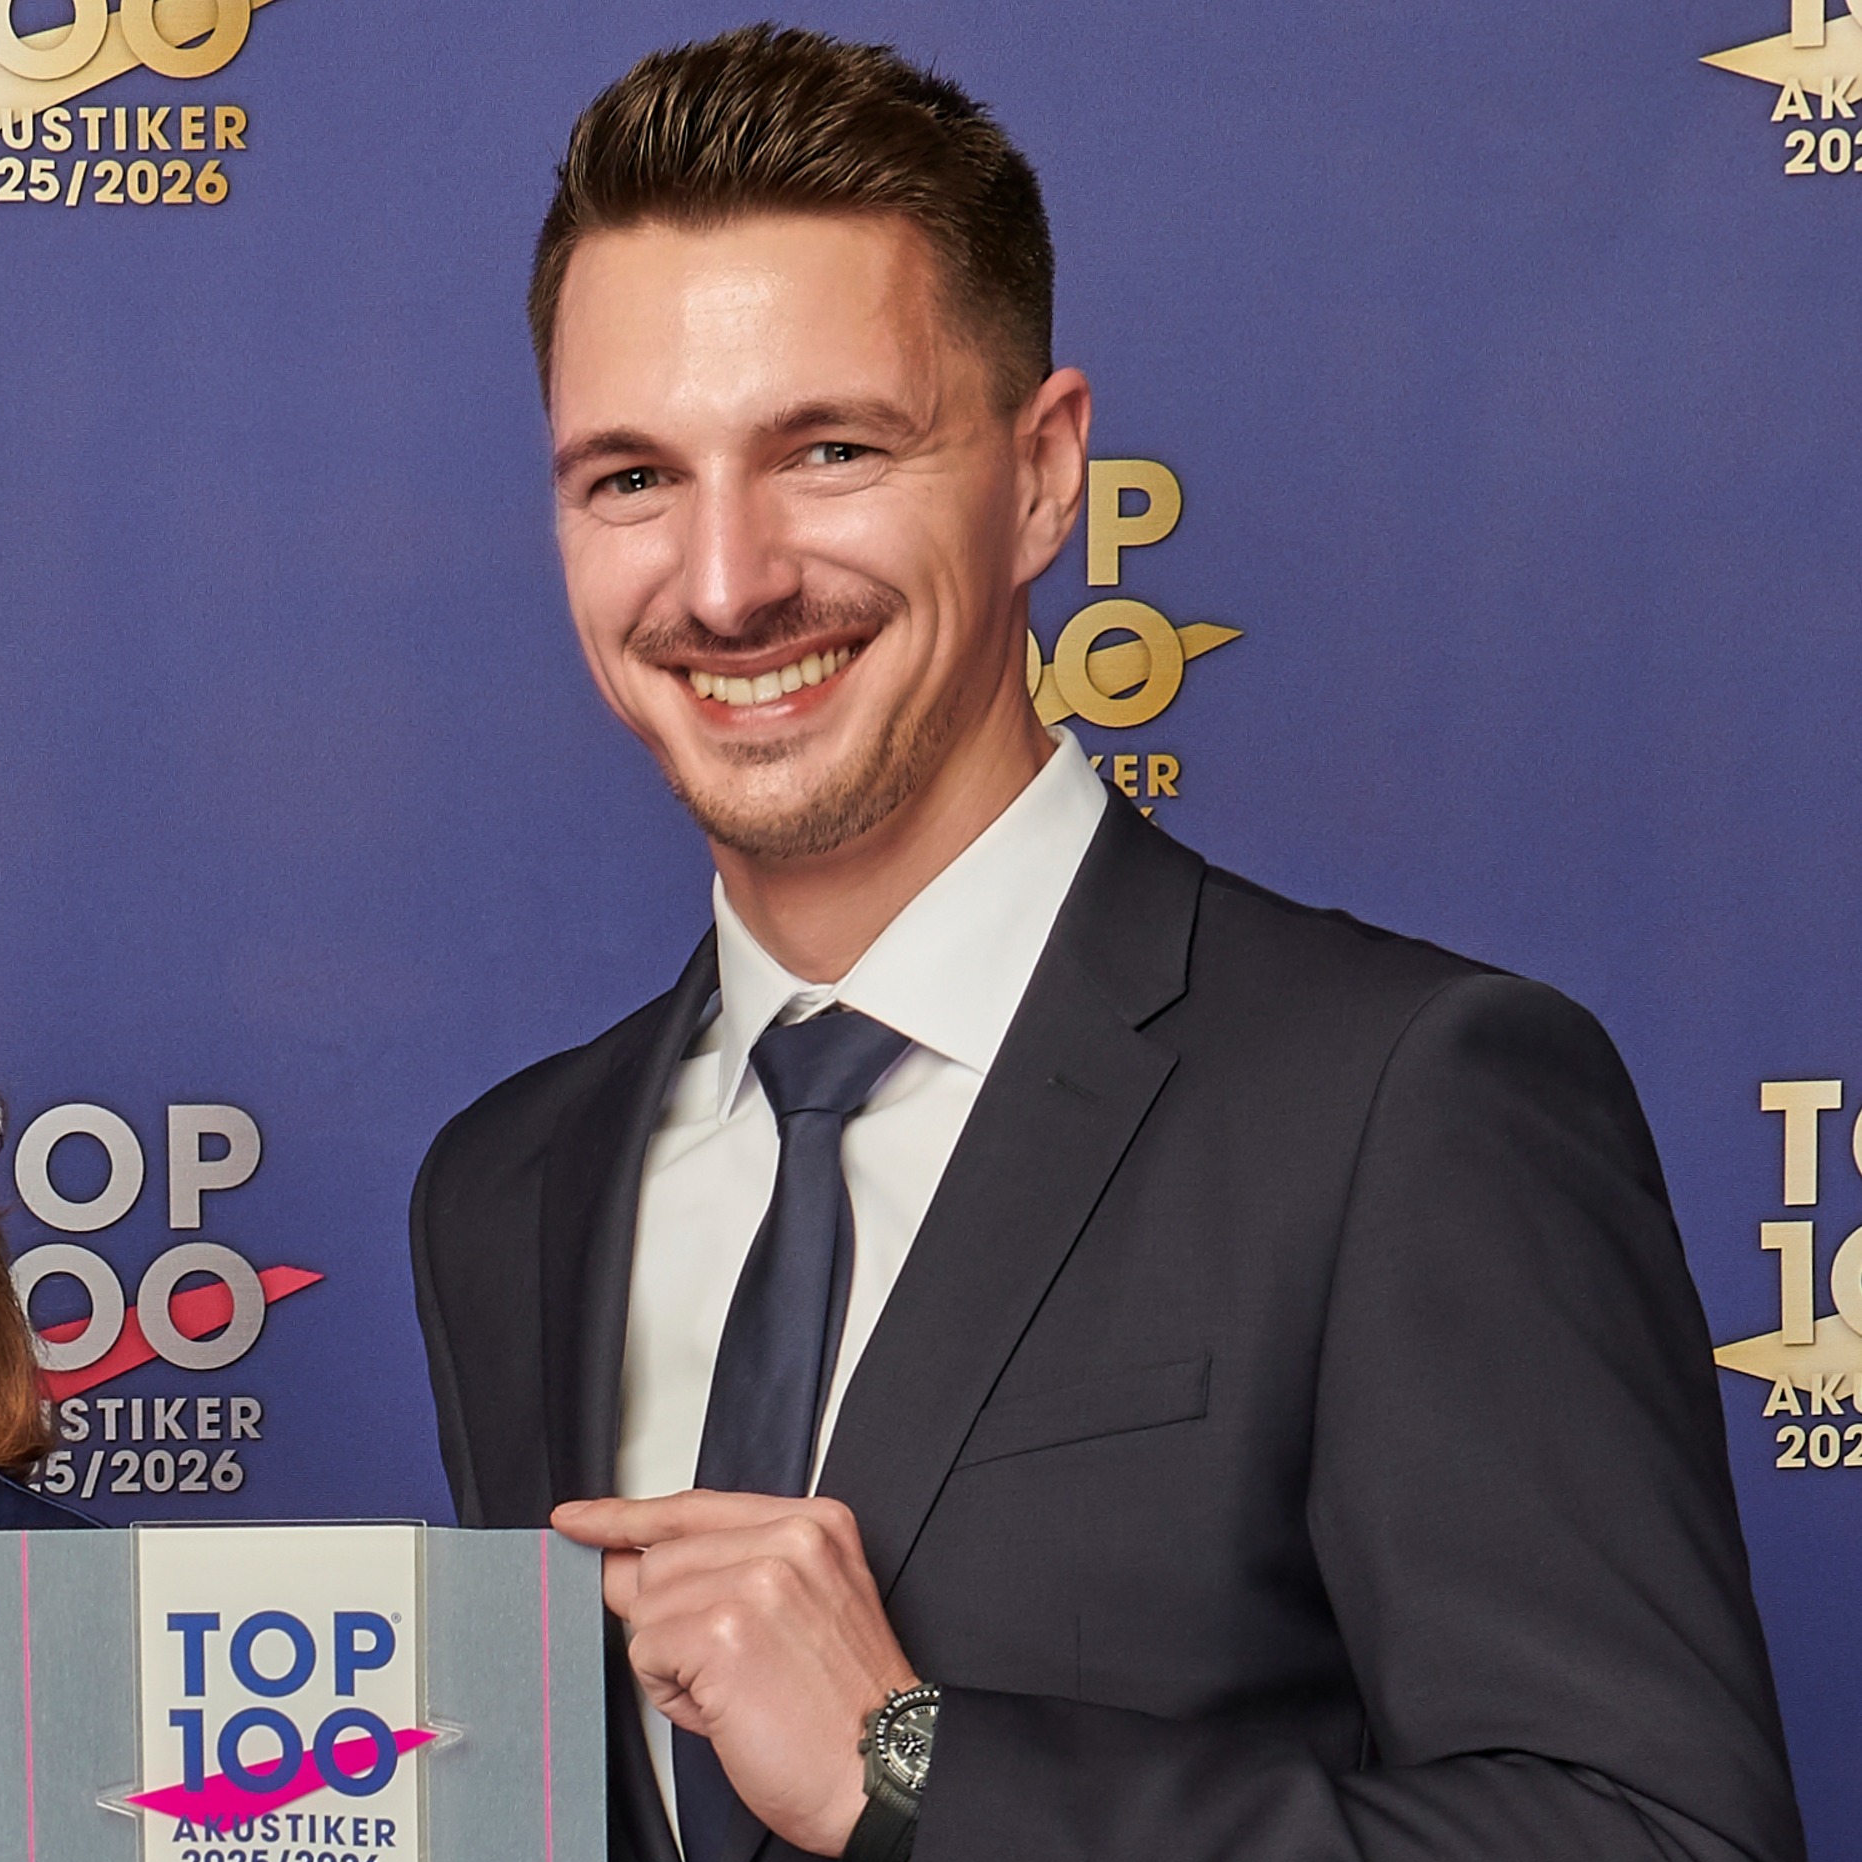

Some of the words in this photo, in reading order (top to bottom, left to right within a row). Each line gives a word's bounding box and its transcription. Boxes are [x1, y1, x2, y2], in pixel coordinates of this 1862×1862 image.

[8, 1242, 266, 1371] 00
[40, 1397, 263, 1441] STIKER
[27, 1449, 245, 1499] 5/2026
[166, 1610, 397, 1698] TOP
[169, 1706, 399, 1797] 100
[172, 1813, 397, 1848] AKUSTIKER
